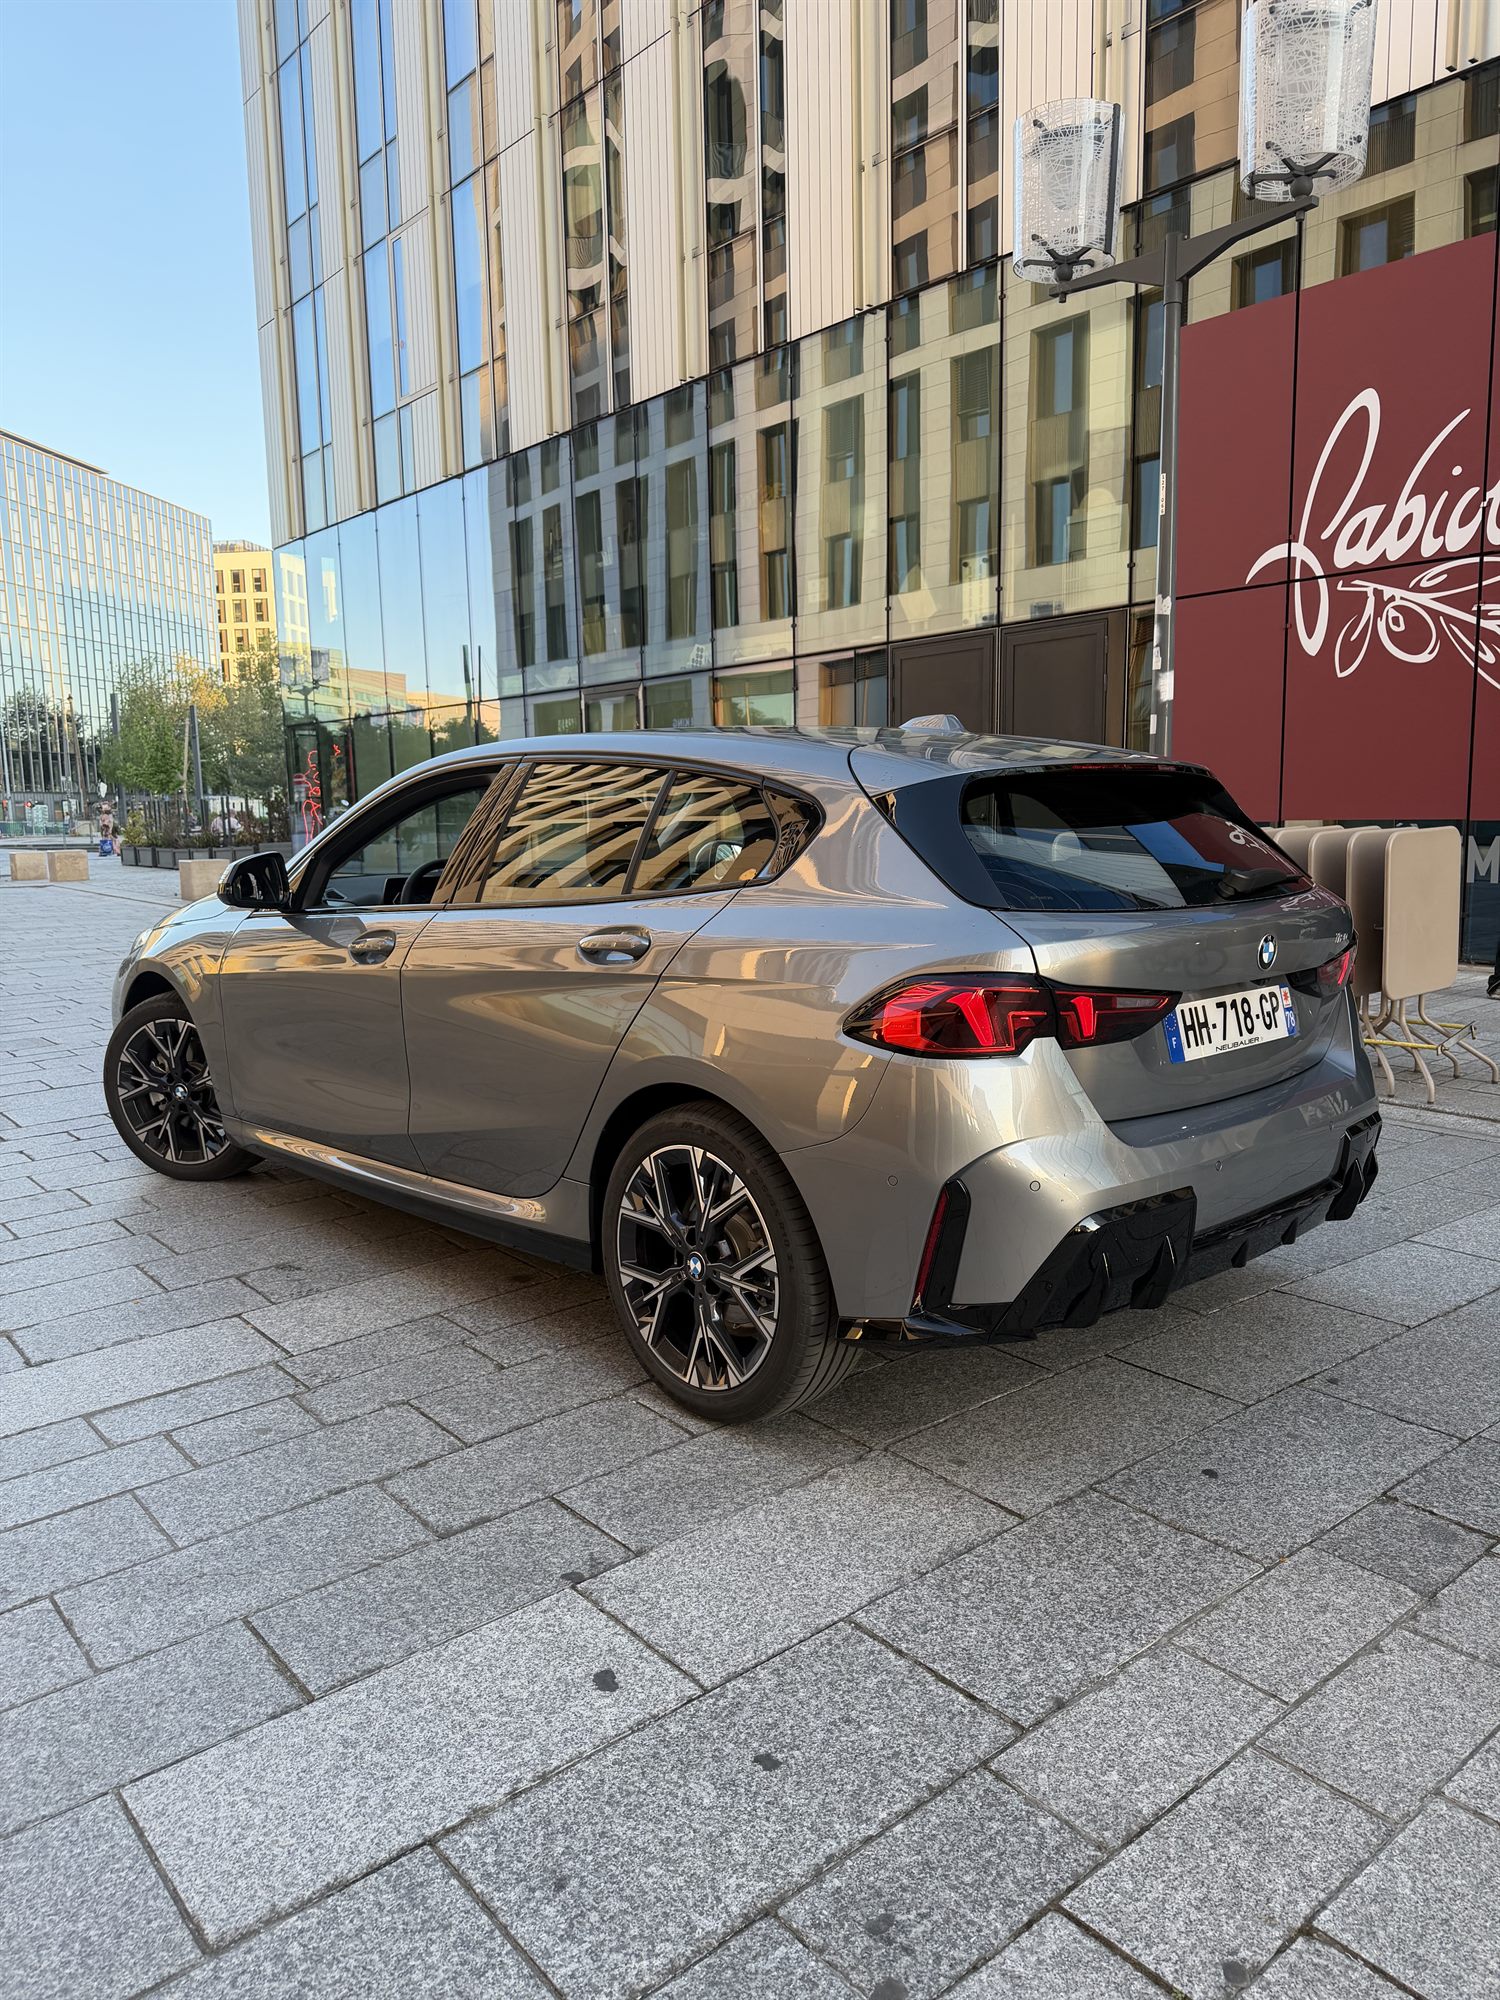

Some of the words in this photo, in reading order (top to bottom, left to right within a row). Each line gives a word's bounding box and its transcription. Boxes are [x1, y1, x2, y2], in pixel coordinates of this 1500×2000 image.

[1180, 991, 1280, 1049] HH-718-GP
[1285, 1010, 1296, 1028] 78
[1215, 1036, 1260, 1052] NEUBAUER
